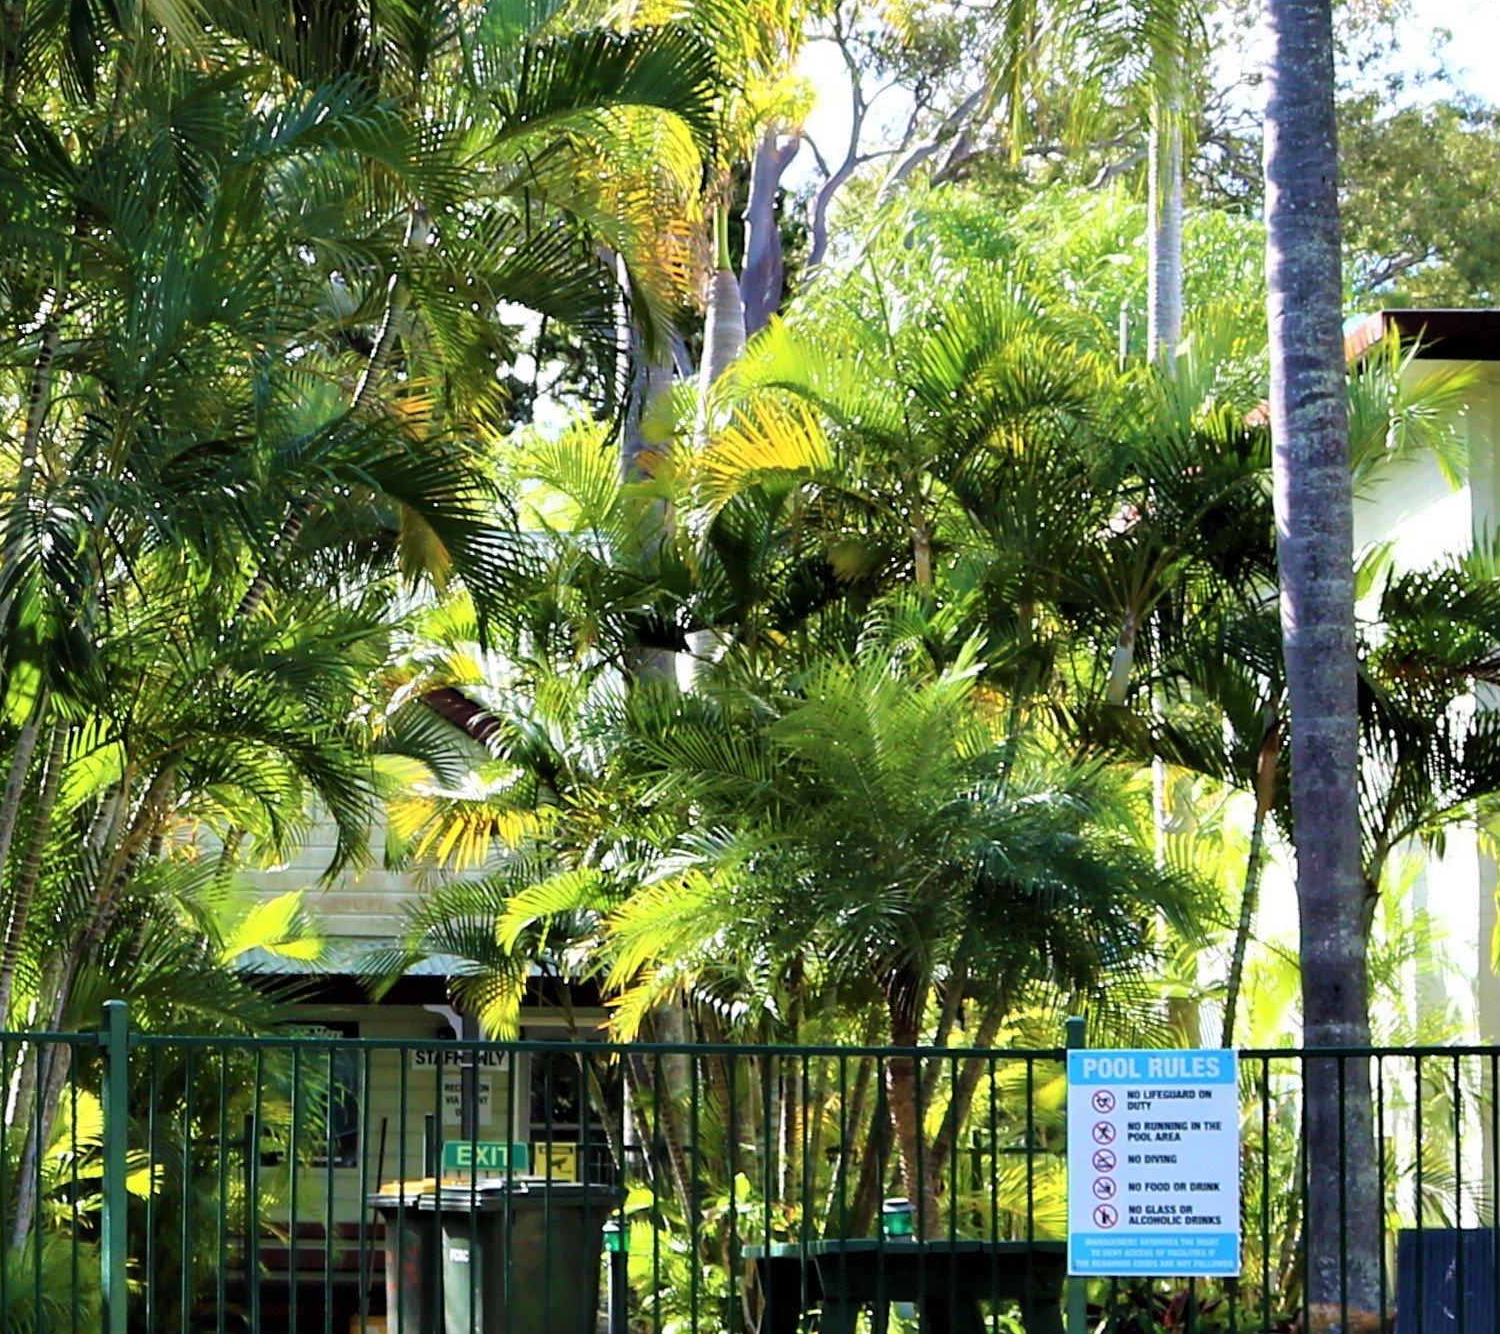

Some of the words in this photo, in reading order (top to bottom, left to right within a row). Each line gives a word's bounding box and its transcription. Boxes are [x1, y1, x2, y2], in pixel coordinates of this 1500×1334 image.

[415, 1050, 463, 1065] STFF
[1082, 1057, 1142, 1079] POOL
[1149, 1057, 1221, 1079] RULES
[1127, 1090, 1142, 1099] NO
[1143, 1090, 1195, 1099] LIFEGUARD
[1198, 1090, 1212, 1099] ON
[1127, 1102, 1152, 1110] DUTY
[1128, 1122, 1142, 1131] NO
[1144, 1122, 1188, 1131] RUNNING
[1191, 1122, 1201, 1131] IN
[1204, 1122, 1222, 1131] THE
[1128, 1132, 1153, 1142] POOL
[1155, 1132, 1181, 1142] AREA
[456, 1146, 508, 1167] EXIT
[1128, 1155, 1142, 1164] NO
[1145, 1155, 1178, 1164] DIVING
[1128, 1182, 1142, 1192] NO
[1145, 1182, 1171, 1192] FOOD
[1173, 1182, 1187, 1192] OR
[1190, 1182, 1221, 1192] DRINK
[1128, 1205, 1143, 1214] NO
[1145, 1205, 1176, 1214] GLASS
[1178, 1205, 1193, 1214] OR
[1128, 1216, 1183, 1225] ALCOHOLIC
[1185, 1216, 1222, 1225] DRINKS
